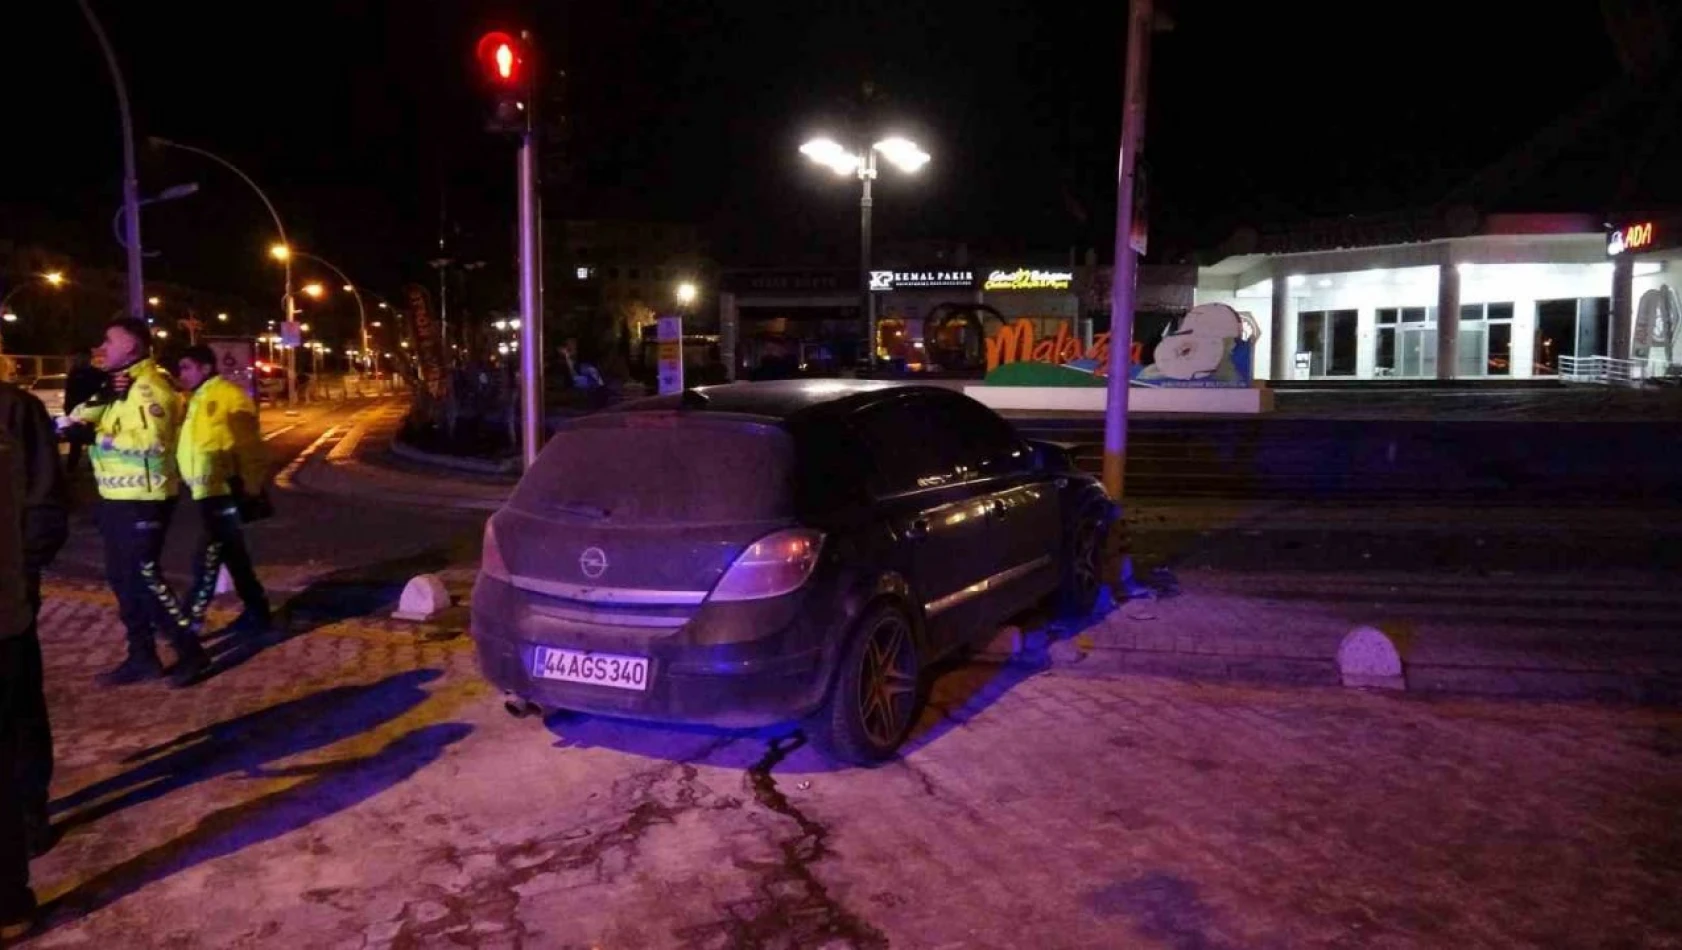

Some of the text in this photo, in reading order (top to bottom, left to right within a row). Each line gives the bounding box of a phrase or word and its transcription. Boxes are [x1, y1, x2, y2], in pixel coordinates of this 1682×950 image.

[1624, 222, 1652, 249] ADA
[895, 272, 935, 281] KEMAL
[983, 317, 1143, 378] Malata
[546, 651, 645, 685] 44AGS340
